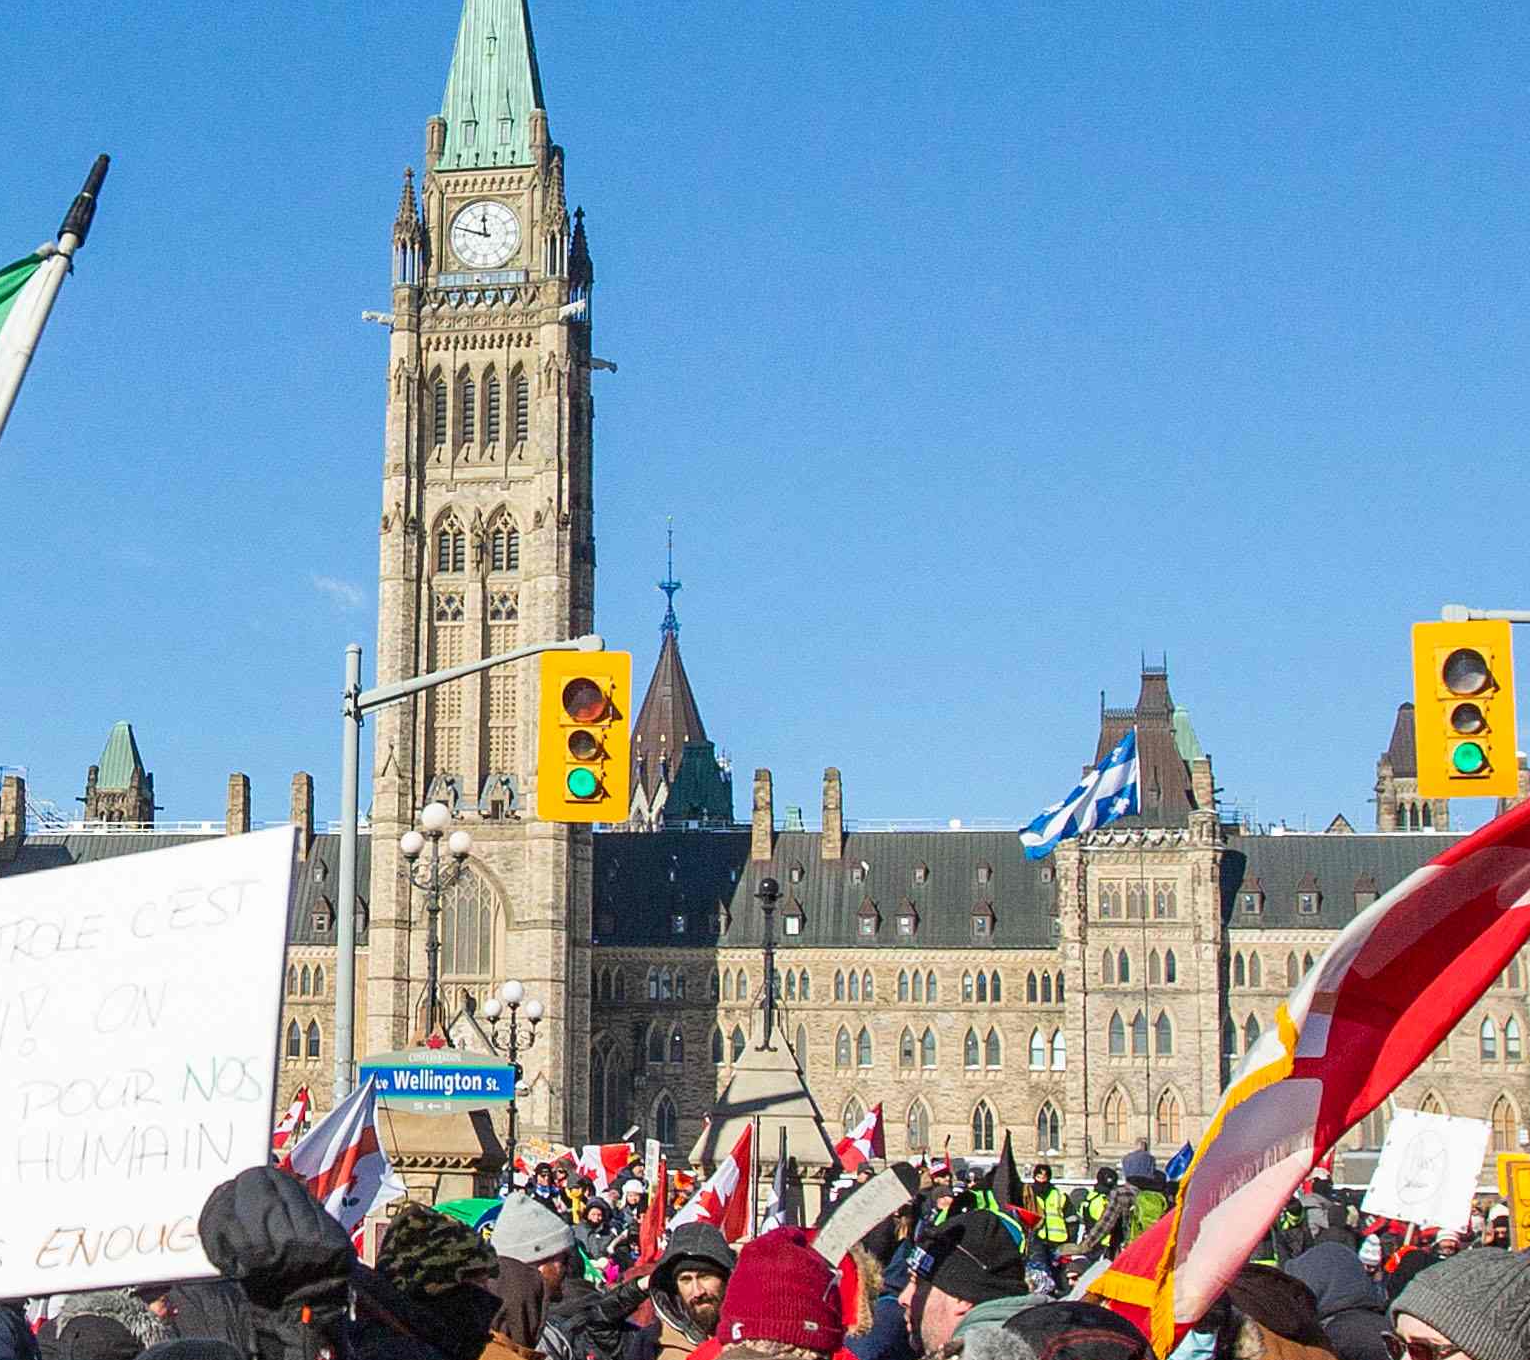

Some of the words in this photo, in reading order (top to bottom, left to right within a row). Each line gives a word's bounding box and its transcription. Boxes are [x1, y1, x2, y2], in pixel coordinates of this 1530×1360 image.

[95, 981, 169, 1034] ON
[19, 1069, 163, 1121] POUR
[182, 1055, 263, 1103] NOS
[393, 1070, 481, 1095] Wellington
[486, 1077, 500, 1091] St.
[16, 1121, 233, 1184] HUMAIN
[35, 1215, 200, 1270] ENOUG
